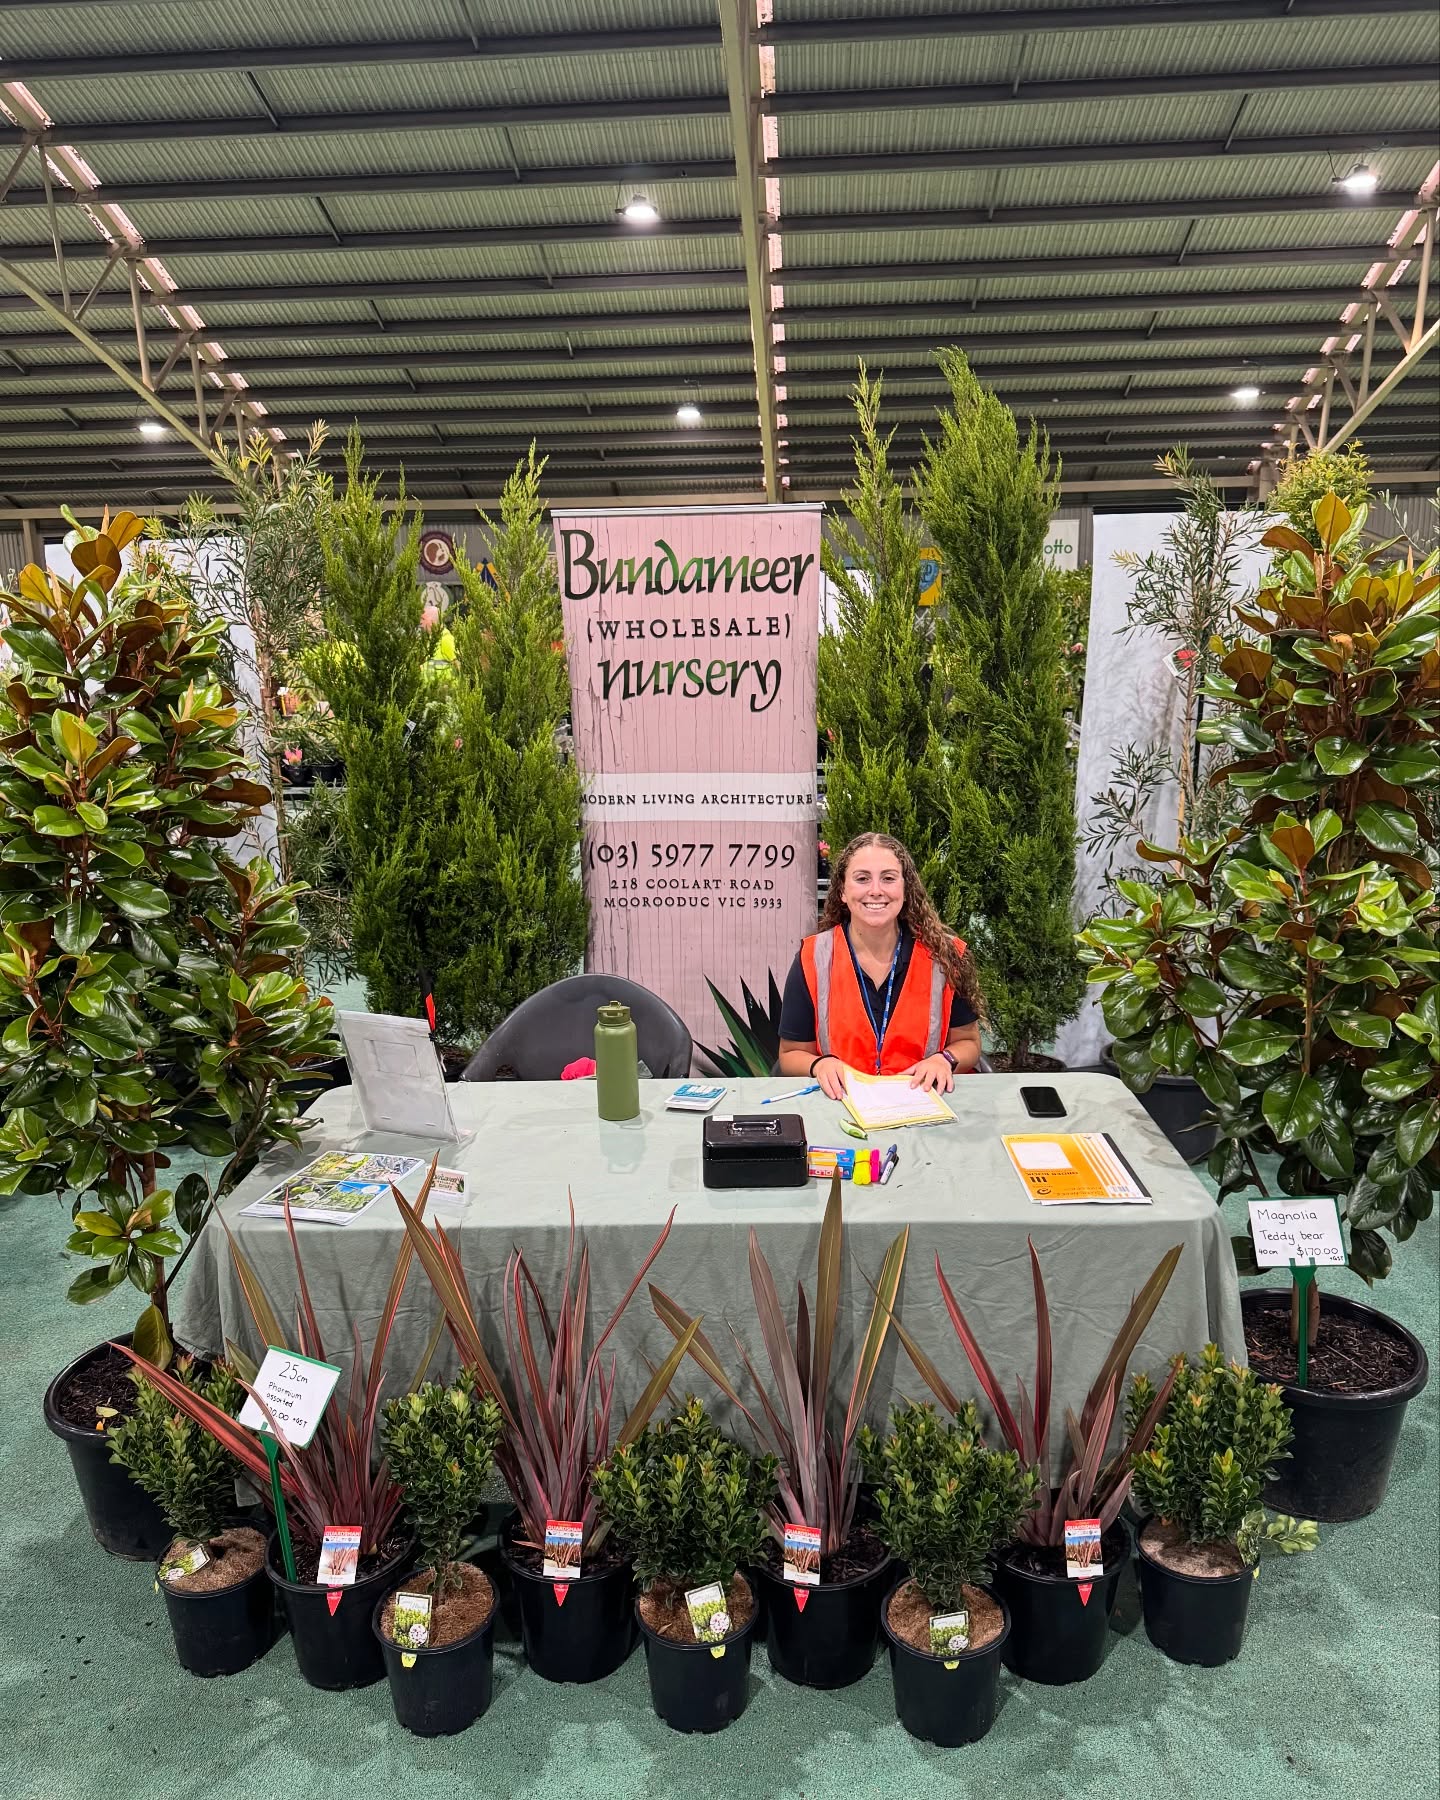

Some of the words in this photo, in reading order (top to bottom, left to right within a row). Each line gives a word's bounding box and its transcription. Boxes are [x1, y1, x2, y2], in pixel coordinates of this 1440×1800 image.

[560, 529, 814, 600] Bundameer
[587, 613, 791, 643] (WHOLESALE)
[597, 658, 782, 712] nursery
[580, 794, 636, 805] MODERN
[642, 794, 695, 805] LIVING
[701, 793, 813, 805] ARCHITECTURE
[589, 841, 638, 870] (03)
[651, 843, 714, 868] 5977
[728, 843, 795, 869] 7799
[610, 878, 638, 889] 218
[646, 878, 722, 889] COOLART
[730, 879, 774, 890] ROAD
[604, 897, 710, 908] MOOROODUC
[718, 897, 746, 908] VIC
[1257, 1209, 1318, 1225] Magnolia
[1259, 1229, 1296, 1245] Teddy
[1300, 1231, 1324, 1240] bear
[1296, 1244, 1339, 1258] $170.00
[266, 1393, 294, 1408] assorted
